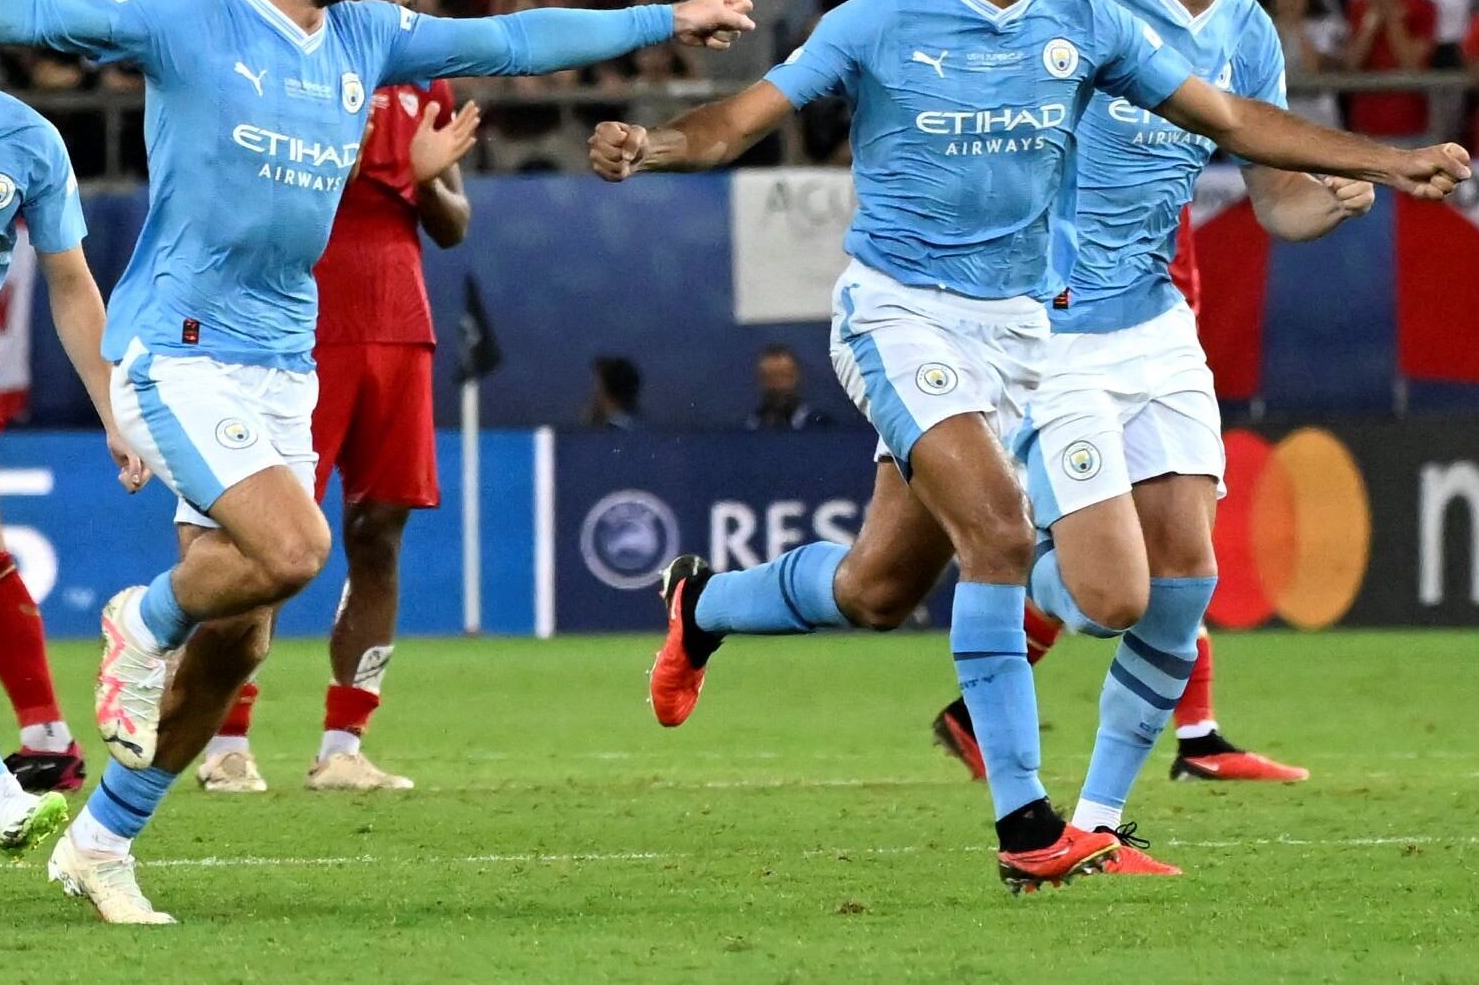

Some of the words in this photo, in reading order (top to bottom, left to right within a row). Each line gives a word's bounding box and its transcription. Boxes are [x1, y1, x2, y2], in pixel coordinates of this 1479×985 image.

[915, 103, 1066, 135] ETIHAD
[232, 124, 360, 169] ETIHAD
[945, 136, 1045, 156] AIRWAYS
[1132, 131, 1212, 146] AIRWAYS
[259, 164, 342, 191] AIRWAYS
[708, 499, 872, 574] RES
